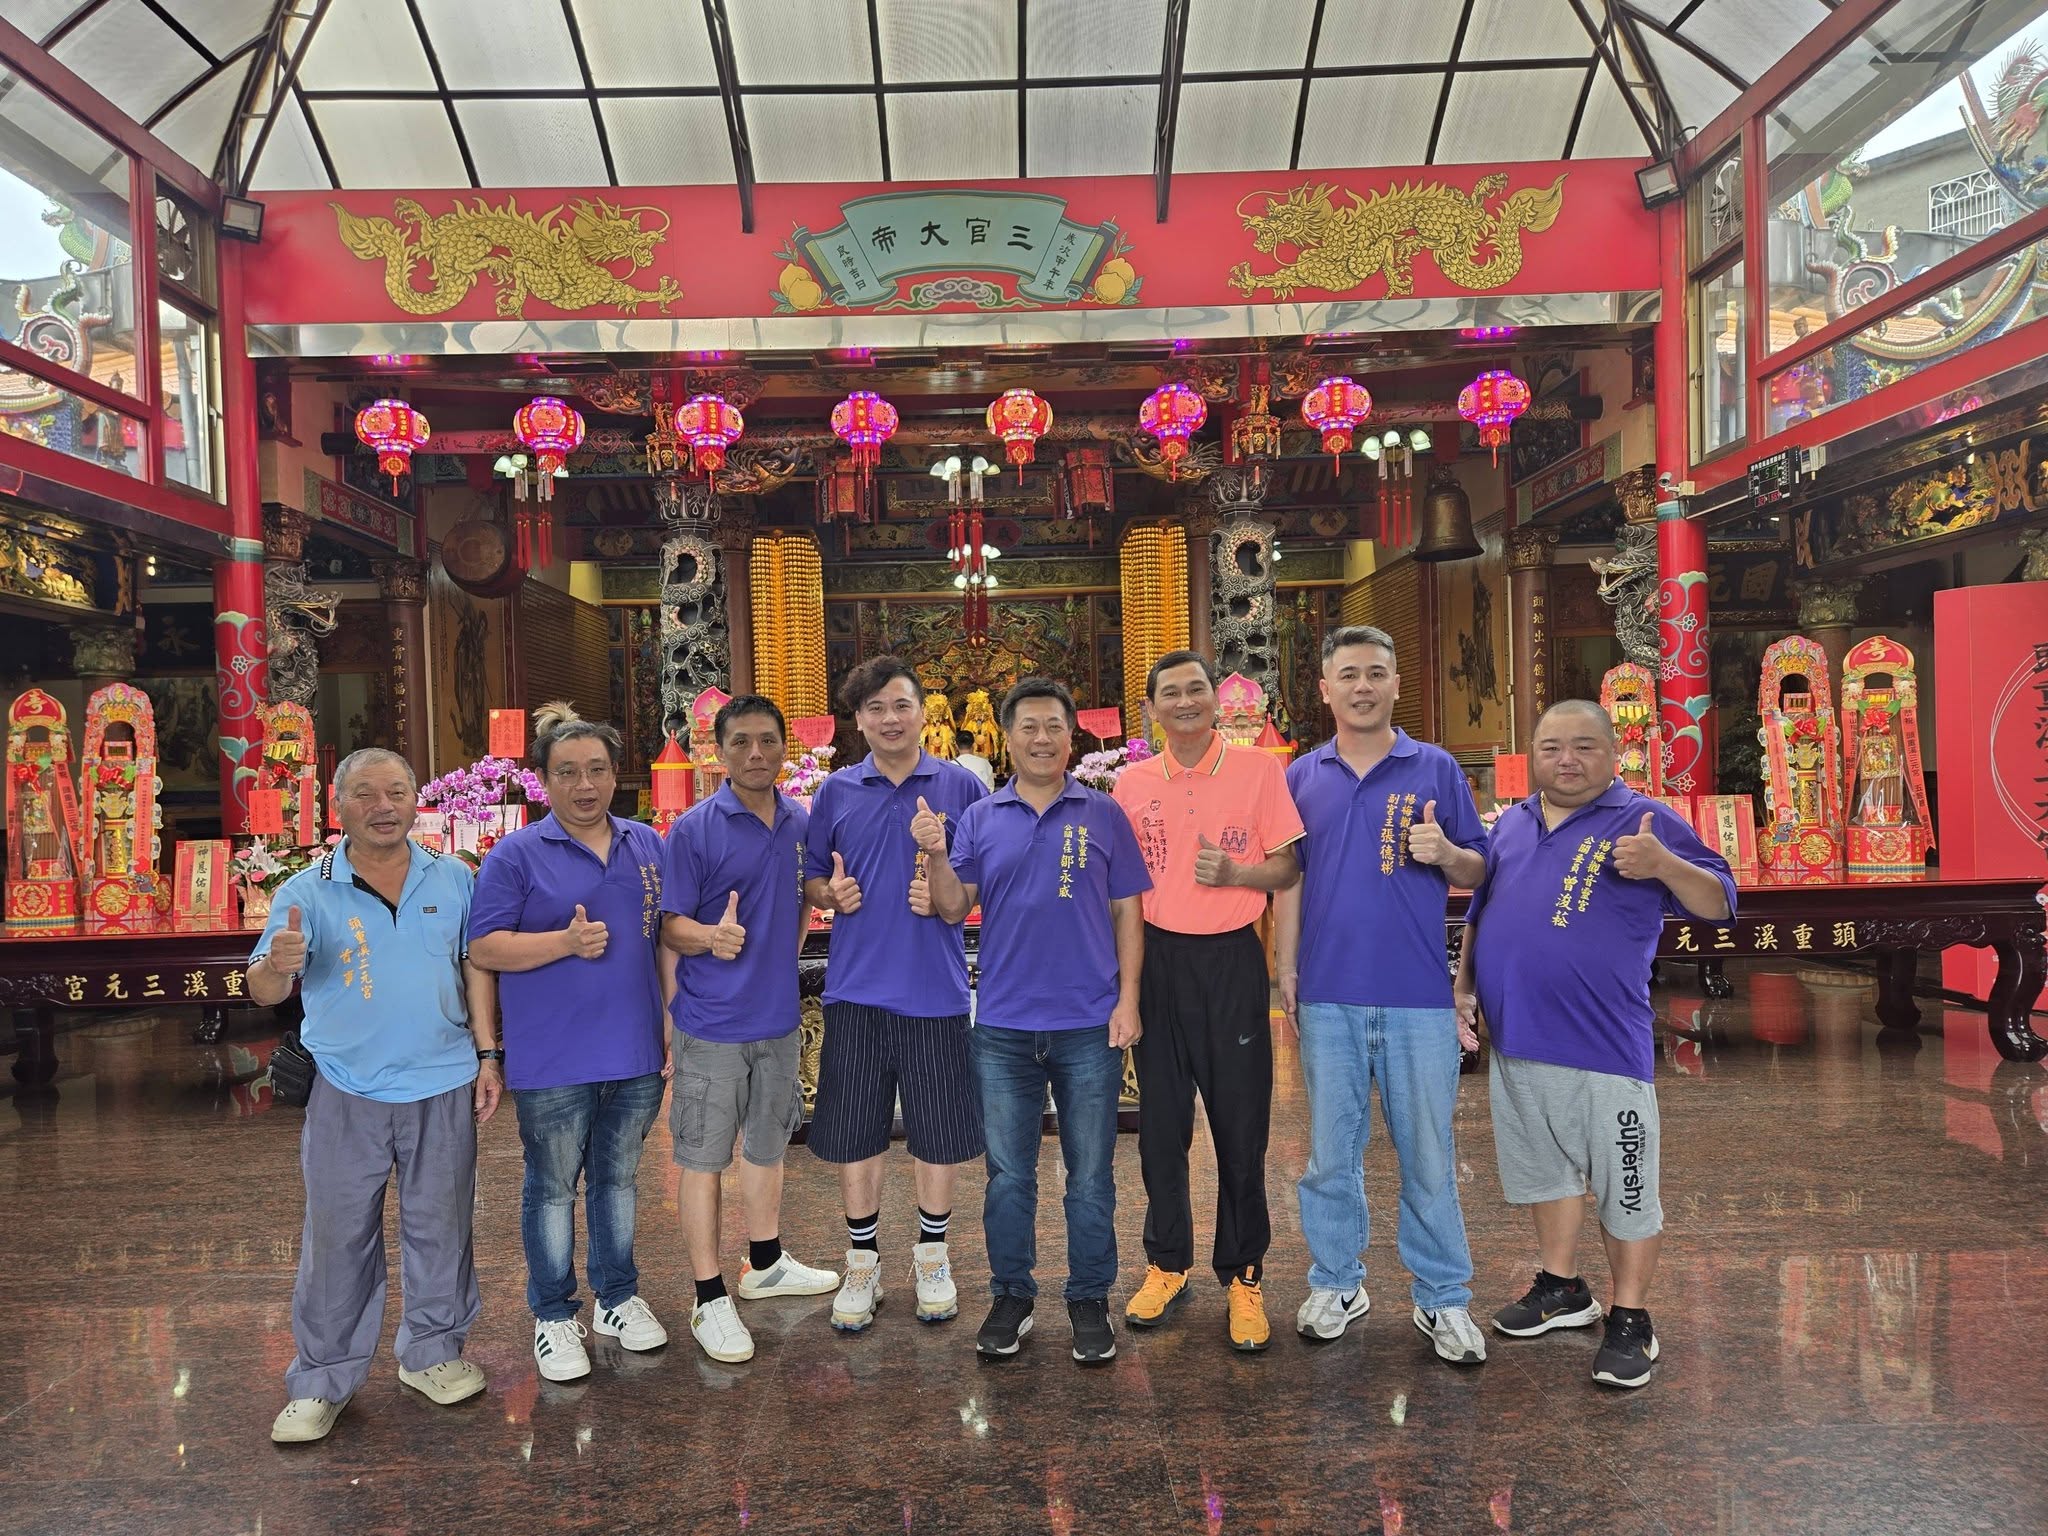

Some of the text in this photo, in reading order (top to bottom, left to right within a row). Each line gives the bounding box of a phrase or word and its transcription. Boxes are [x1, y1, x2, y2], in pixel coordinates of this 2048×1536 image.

[871, 217, 1034, 256] 三官大帝
[836, 245, 867, 292] 良時吉日
[1720, 800, 1737, 858] 神恩佑民
[195, 845, 209, 904] 神恩佑民
[347, 916, 373, 1000] 頭重溪三元宮
[1675, 920, 1858, 952] 頭重溪三元
[64, 969, 246, 1001] 重溪三元宮
[1615, 1108, 1642, 1216] Supershy.
